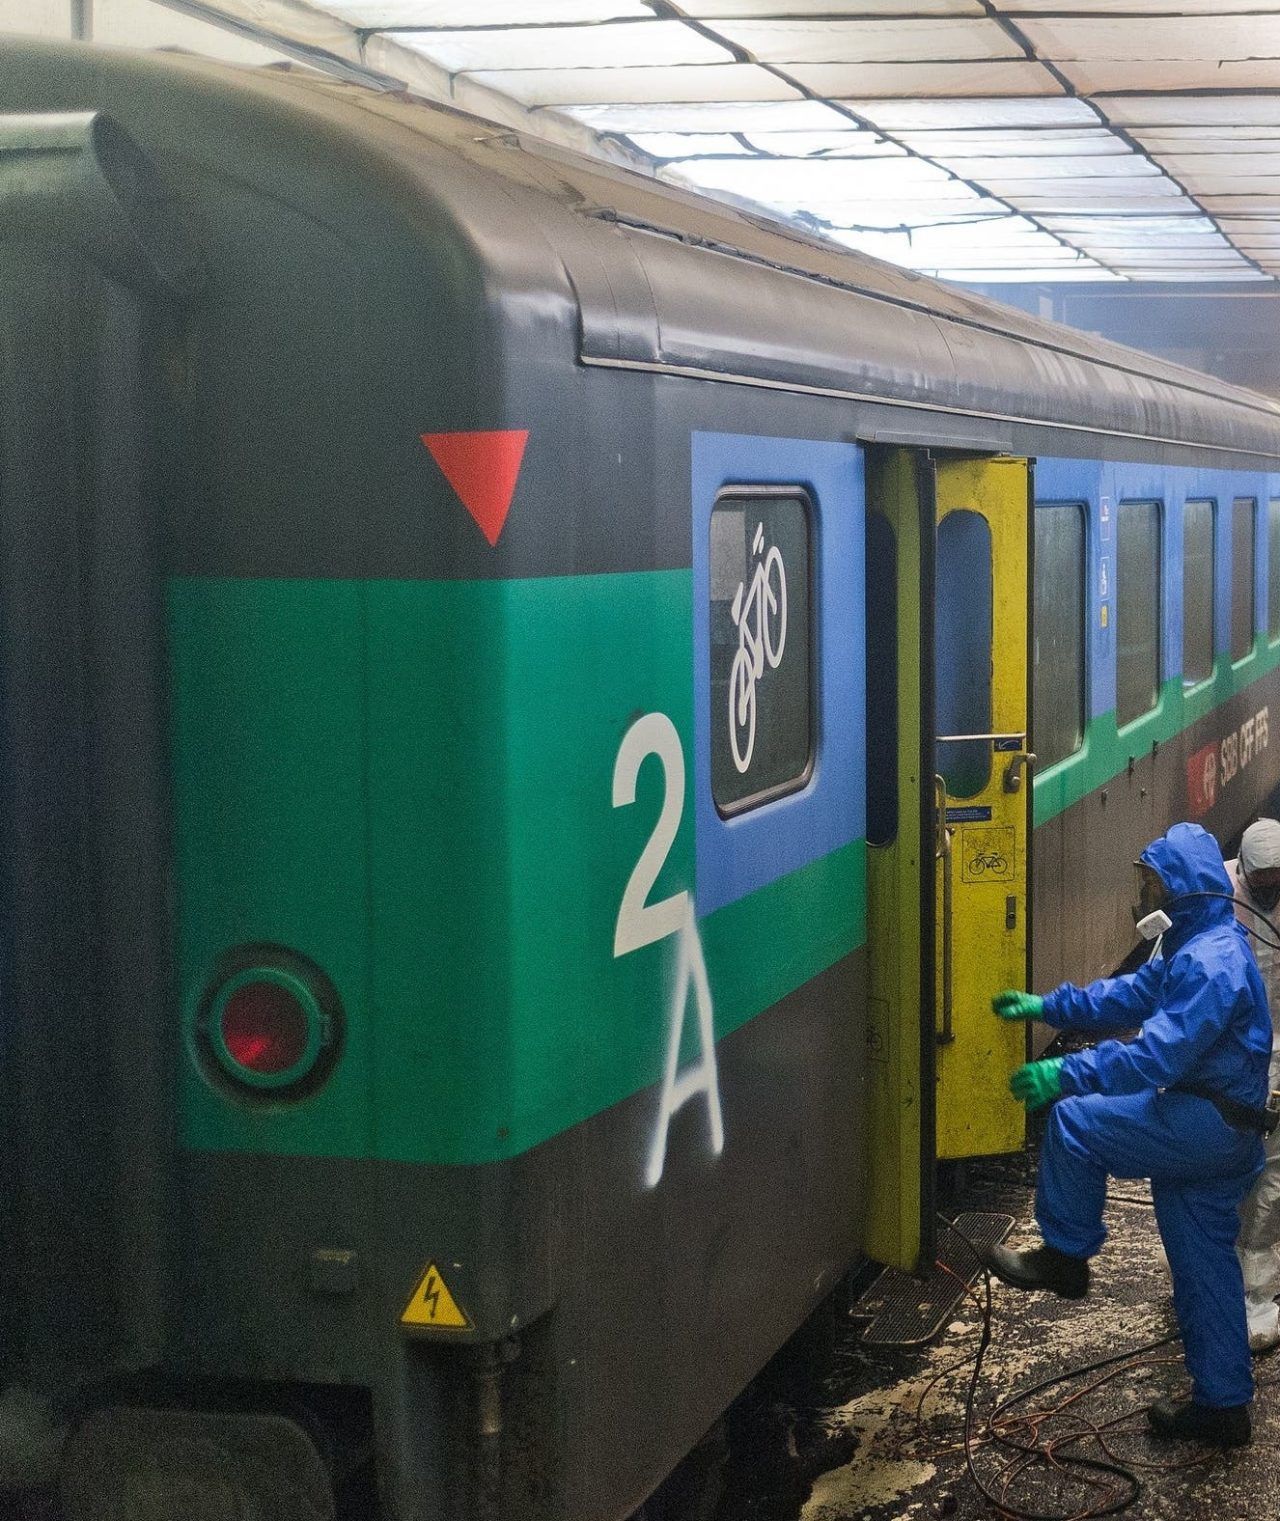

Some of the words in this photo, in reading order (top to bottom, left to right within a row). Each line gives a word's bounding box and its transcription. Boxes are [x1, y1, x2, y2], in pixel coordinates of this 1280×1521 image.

[612, 712, 689, 958] 2
[1220, 731, 1238, 787] SBB
[645, 895, 724, 1188] A
